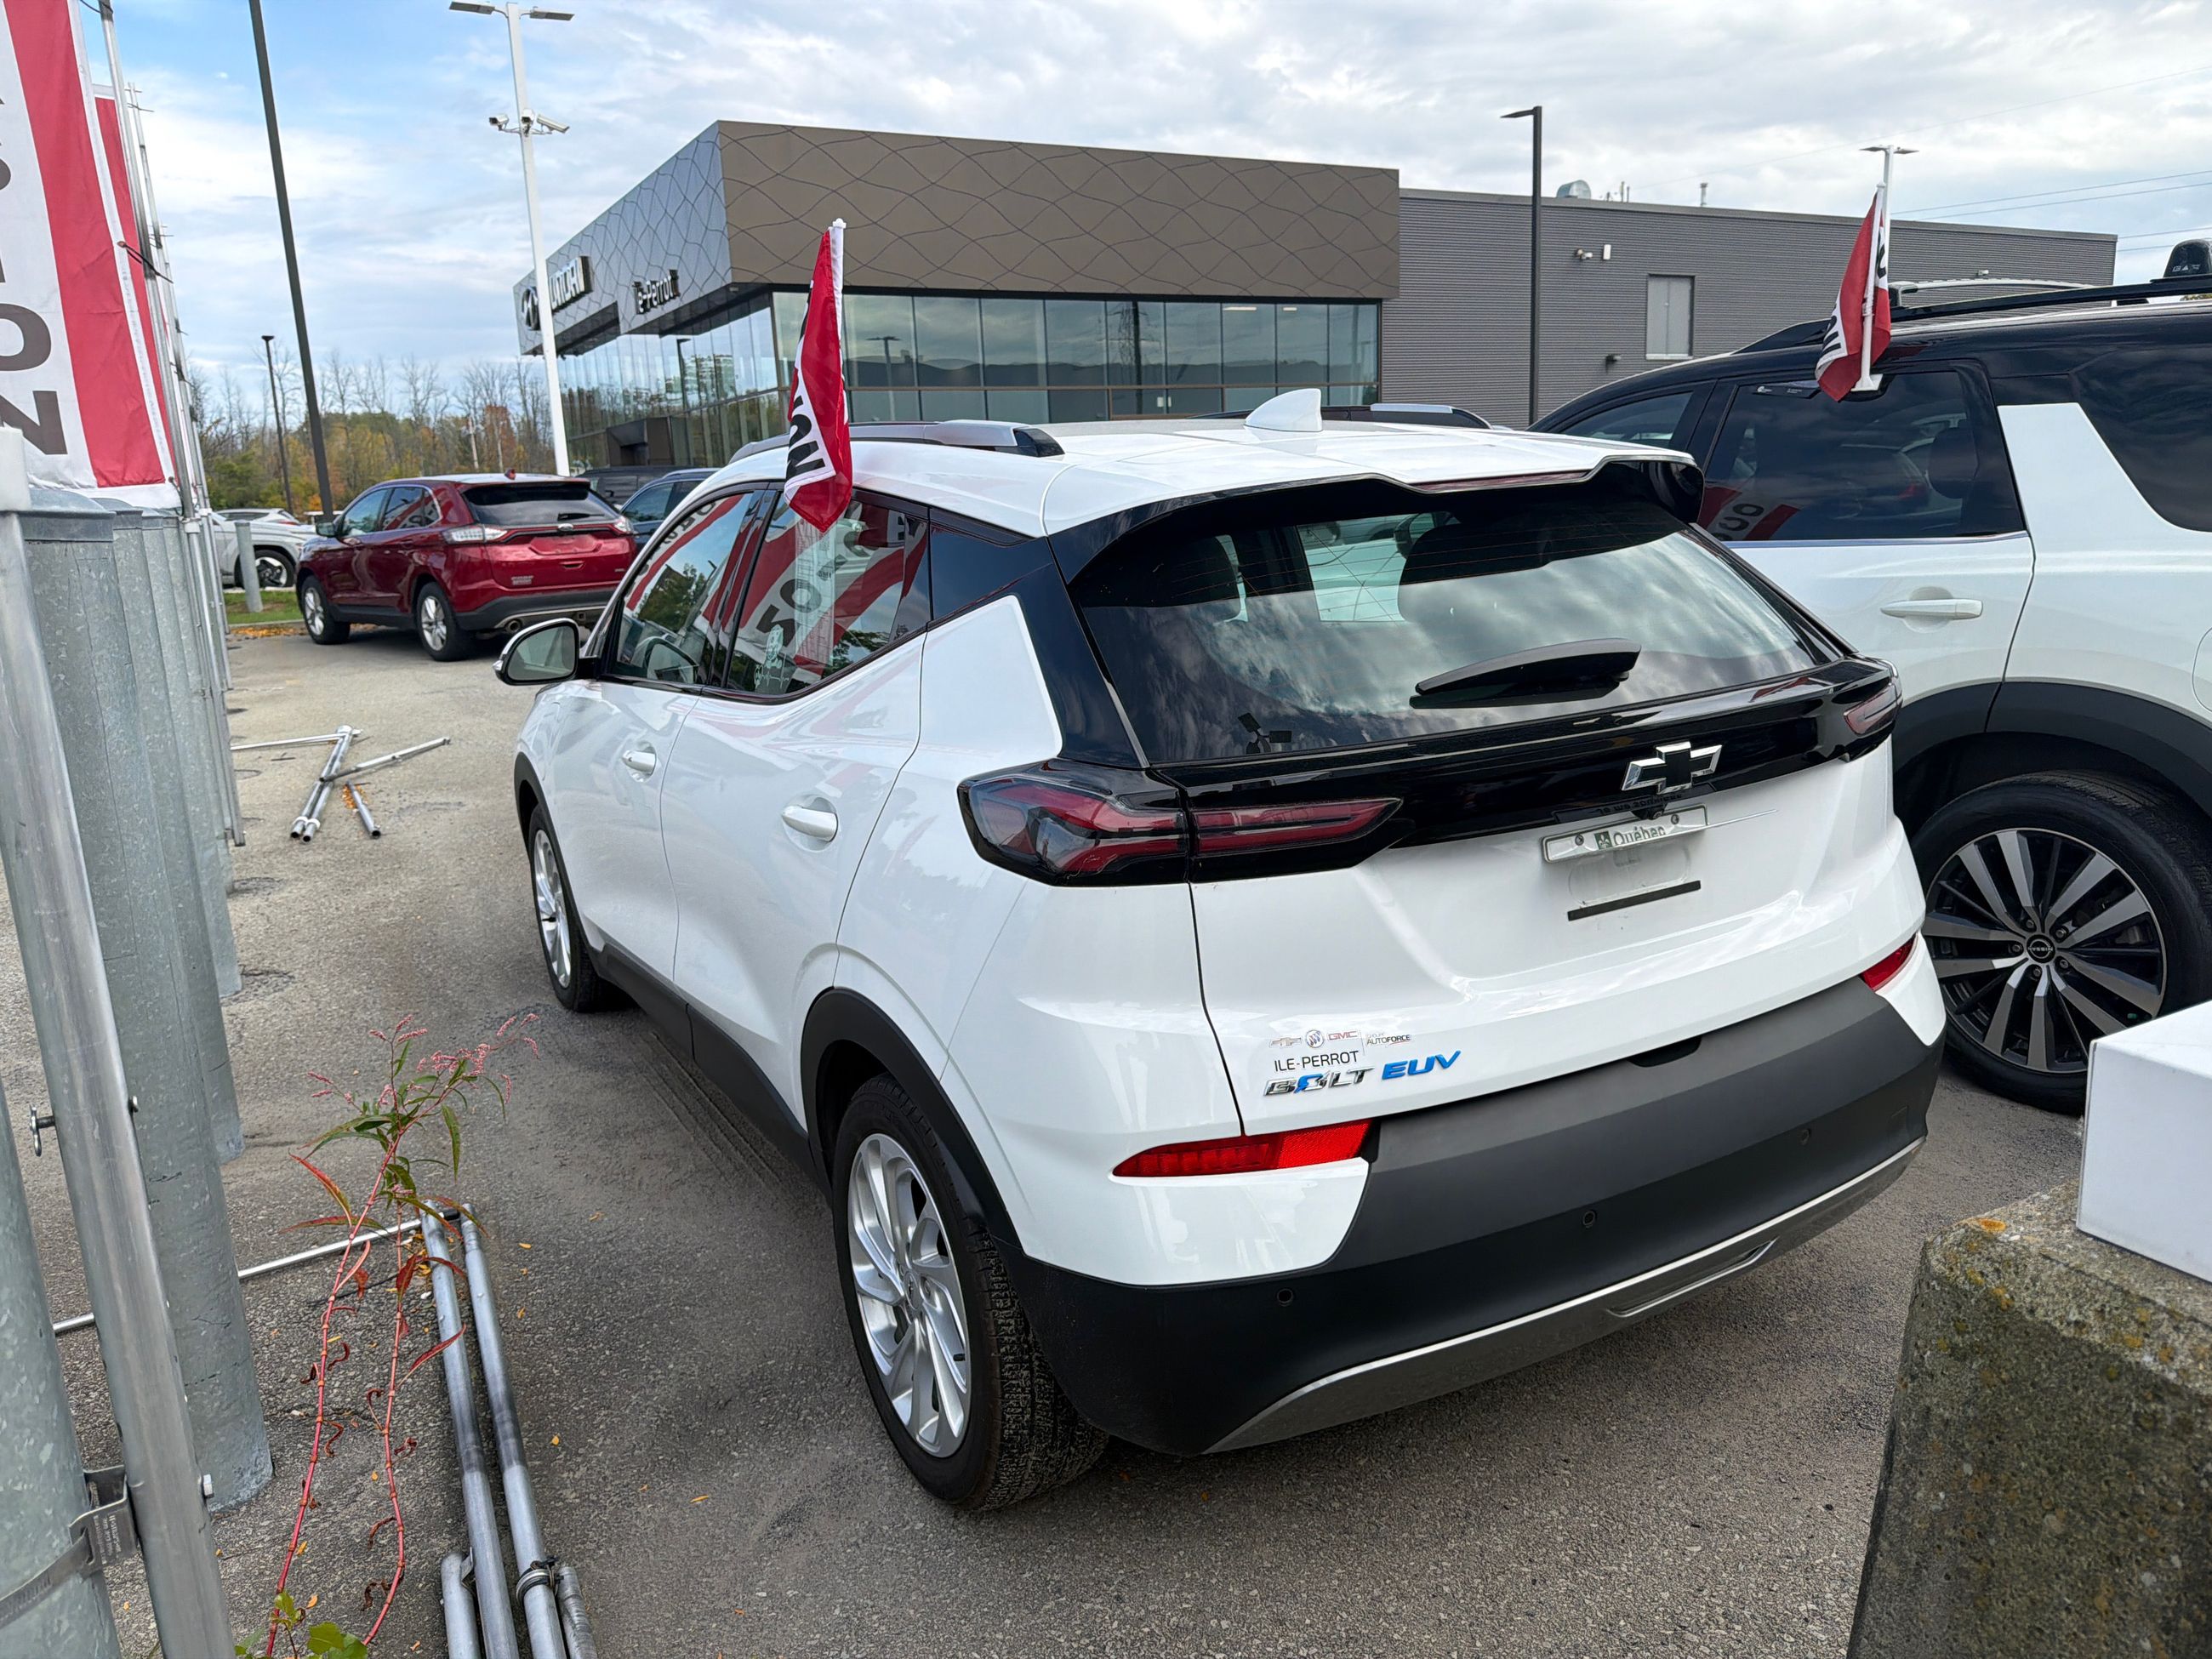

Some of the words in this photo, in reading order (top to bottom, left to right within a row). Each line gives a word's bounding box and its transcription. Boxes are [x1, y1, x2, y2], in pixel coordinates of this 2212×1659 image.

[1613, 826, 1666, 846] Québec
[1328, 1030, 1358, 1040] GMC
[1366, 1035, 1411, 1046] AUTOFORCE
[1274, 1051, 1360, 1072] ILE-PERROT
[1263, 1067, 1375, 1096] BOLT
[1382, 1050, 1462, 1080] EUV
